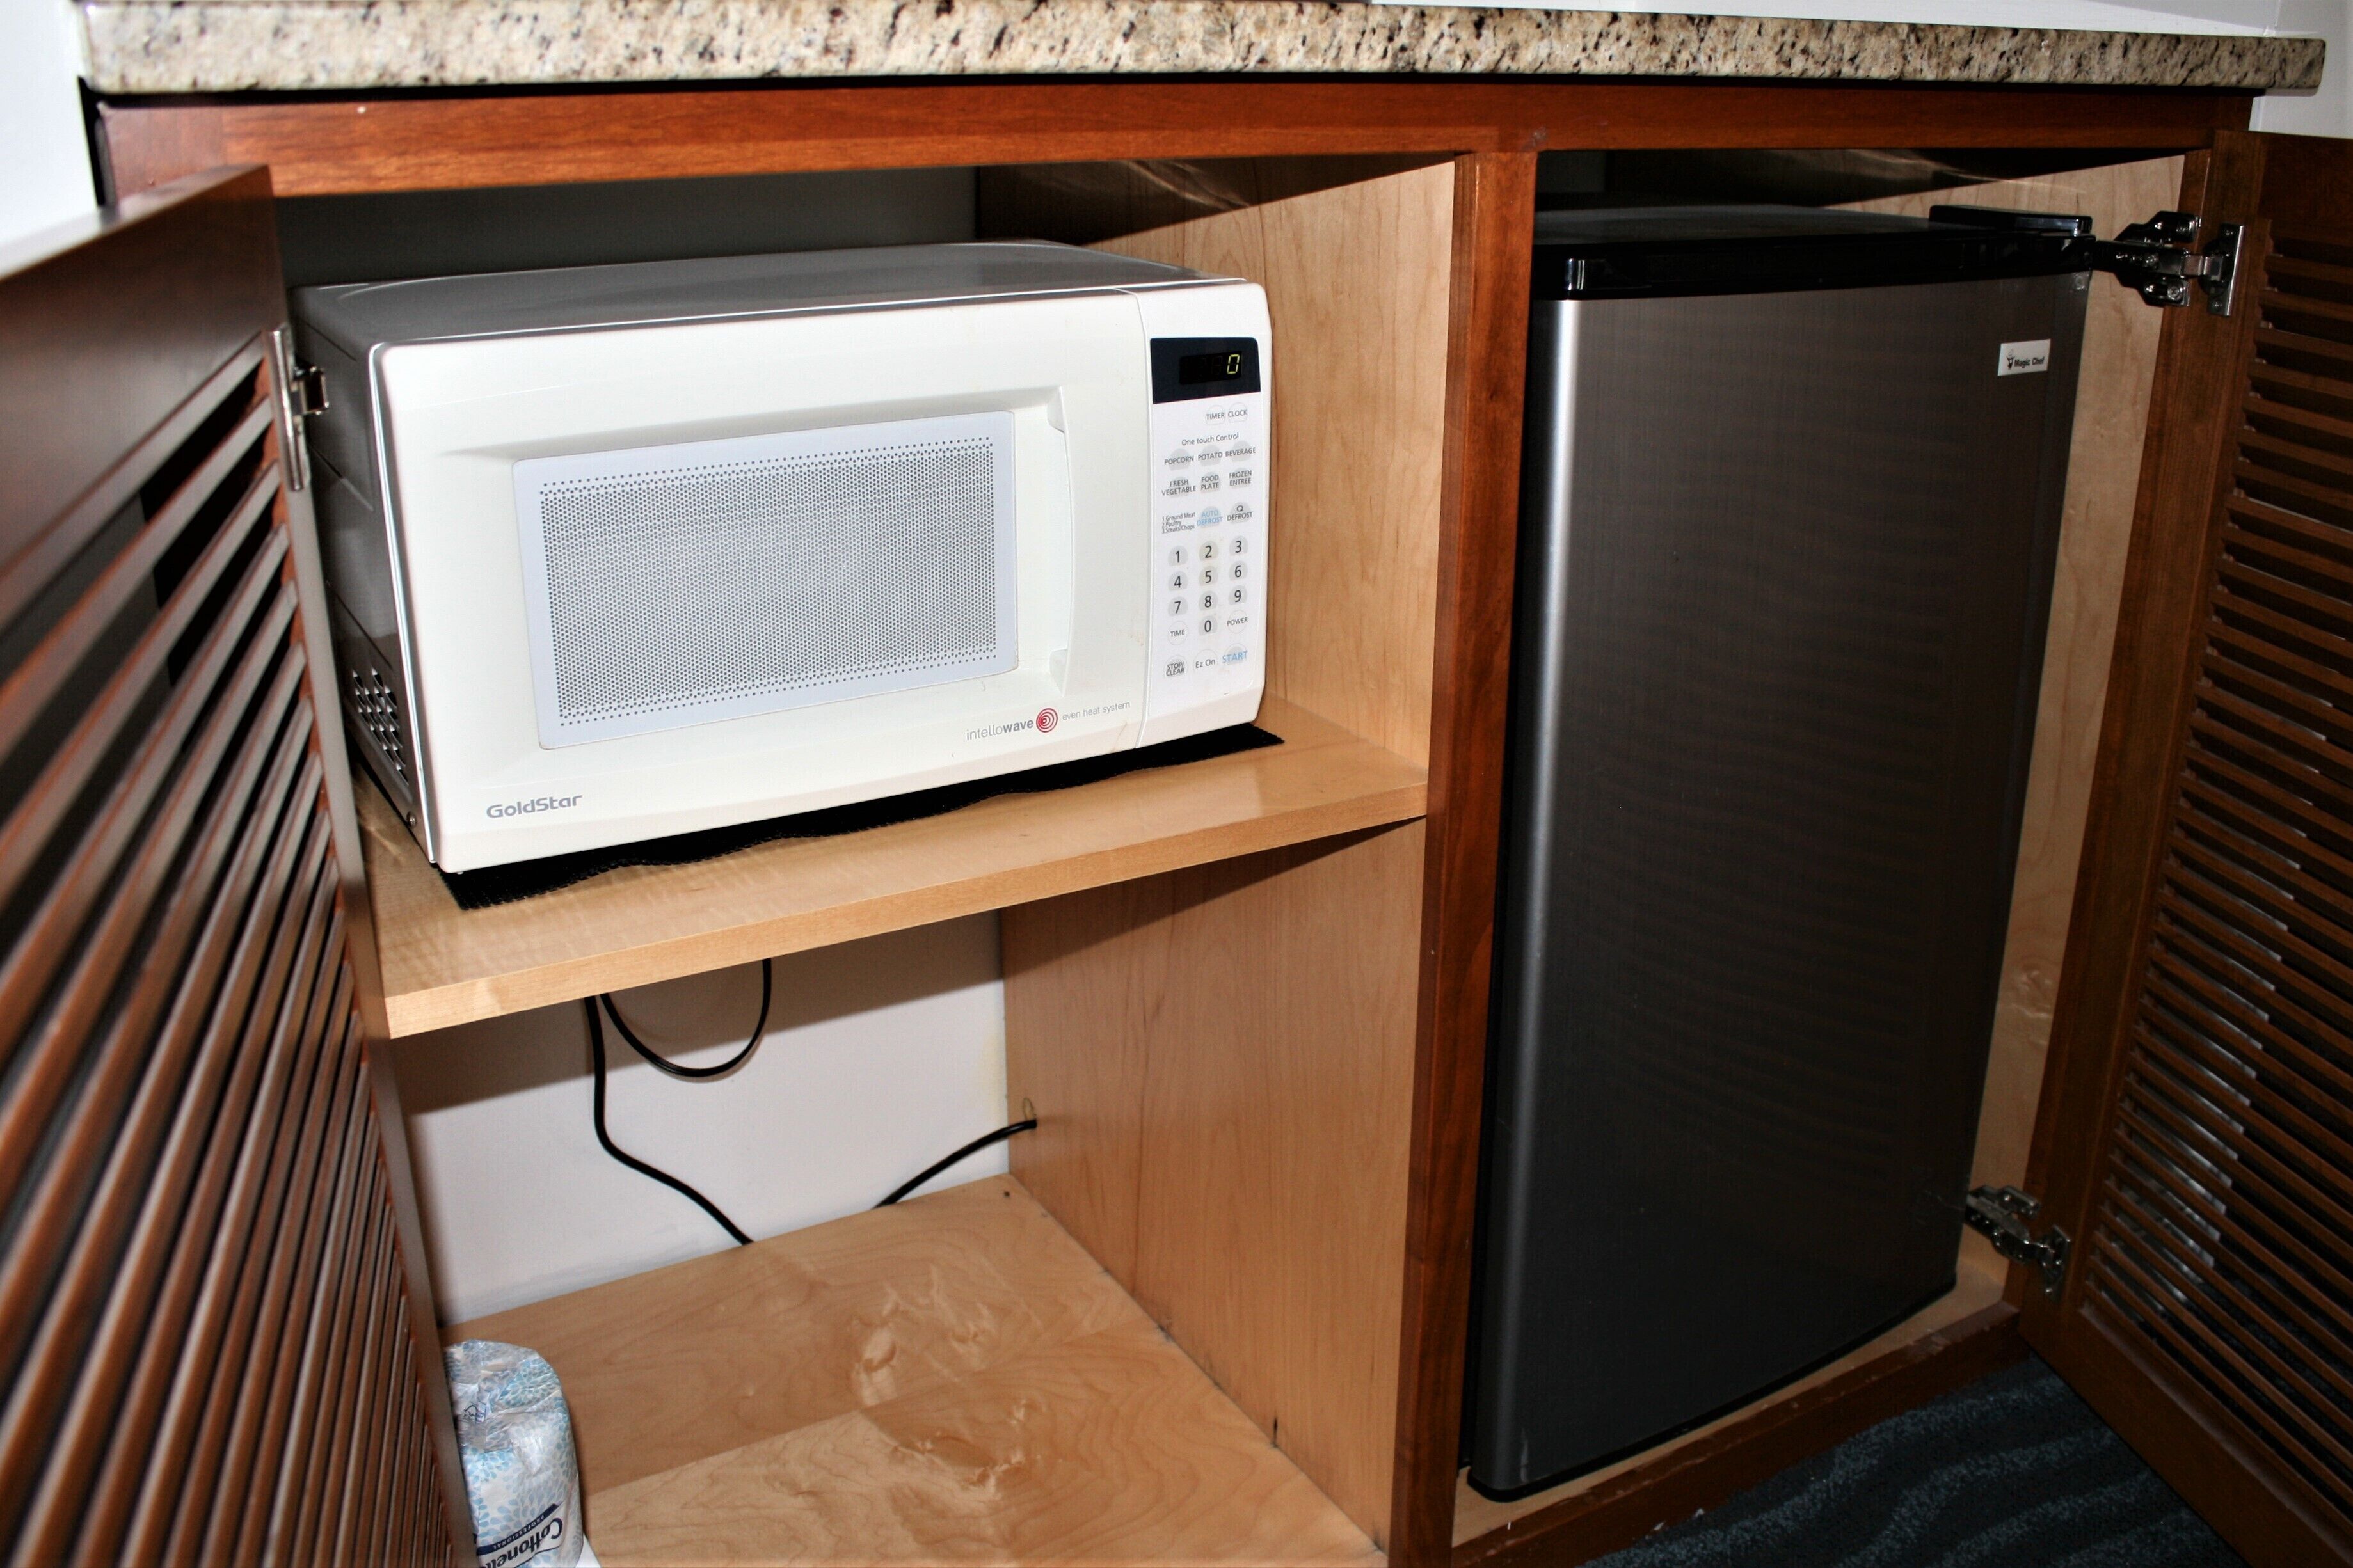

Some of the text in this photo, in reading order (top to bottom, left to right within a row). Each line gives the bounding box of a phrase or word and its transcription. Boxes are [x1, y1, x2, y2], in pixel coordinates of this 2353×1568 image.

[1226, 354, 1240, 374] 0
[2014, 356, 2045, 368] Magic Chef
[1206, 409, 1248, 420] TIMER CLOCK
[1181, 432, 1240, 447] One touch Control
[1164, 447, 1256, 465] POPCORN POTATO BEVERAGE
[1229, 470, 1252, 479] FROZEN
[1170, 479, 1189, 487] FRESH
[1200, 482, 1220, 491] PLATE
[1229, 477, 1252, 486] ENTREE
[1161, 486, 1197, 496] VEGETABLE
[1201, 509, 1220, 518] AUTO
[1227, 512, 1253, 521] DEFROST
[1197, 516, 1224, 527] DEFROST
[1175, 540, 1242, 564] 1 2 3
[1174, 565, 1242, 589] 4 5 6
[1174, 589, 1241, 614] 7 8 9
[1204, 620, 1212, 633] 0
[1227, 617, 1248, 627] POWER
[1170, 629, 1185, 637] TIME
[1222, 650, 1248, 663] START
[1205, 658, 1216, 667] On
[1166, 668, 1184, 677] CLEAR
[966, 701, 1131, 741] intellowave even heat system
[486, 795, 583, 819] GoldStar
[493, 1514, 545, 1550] PROFESSIONAL
